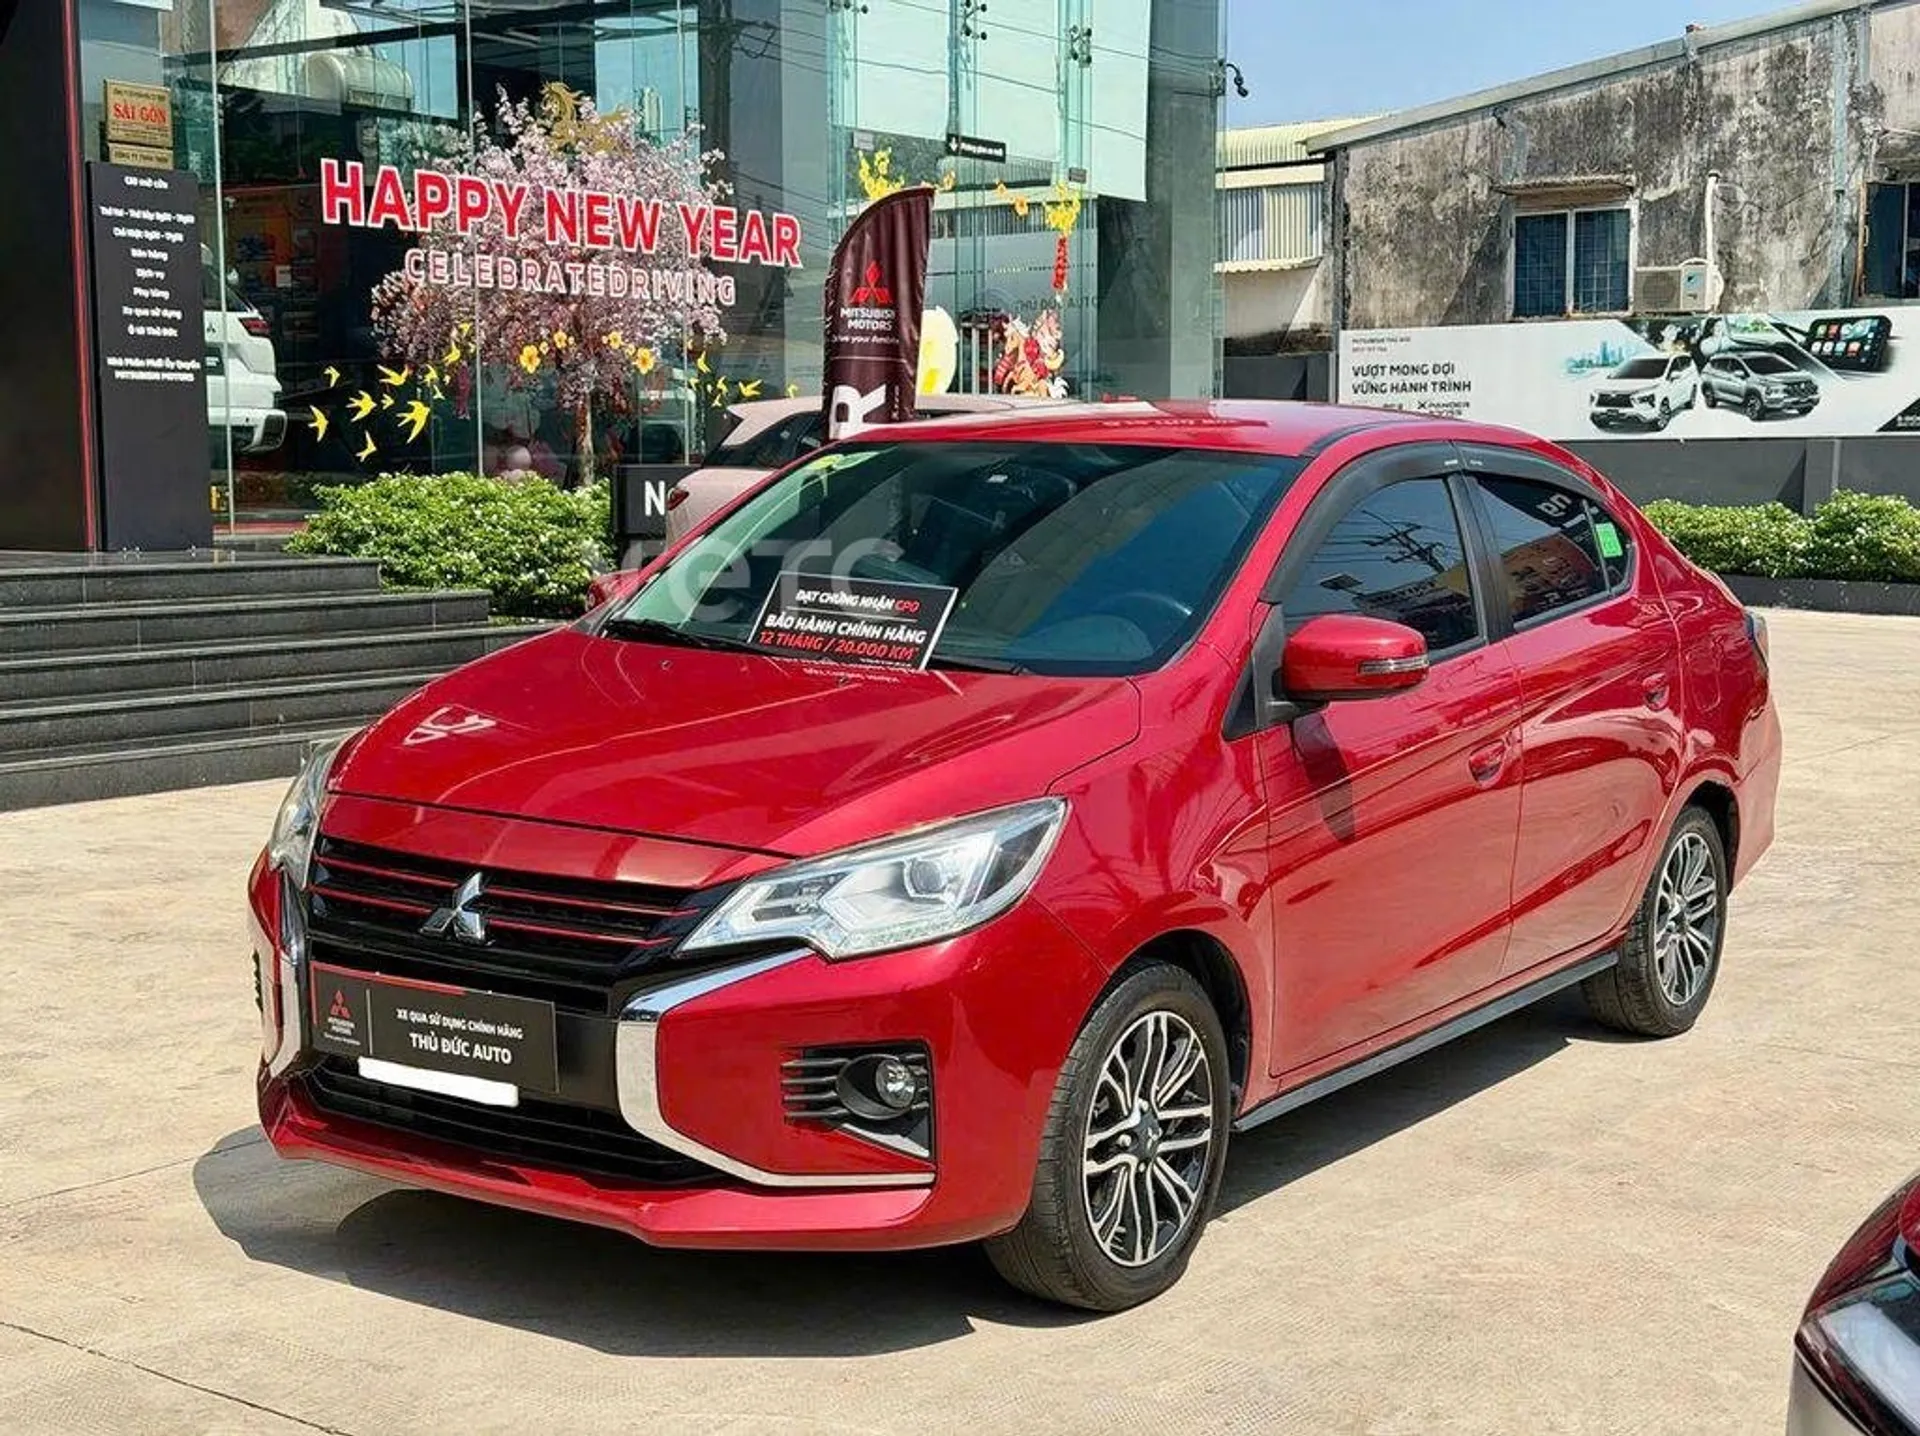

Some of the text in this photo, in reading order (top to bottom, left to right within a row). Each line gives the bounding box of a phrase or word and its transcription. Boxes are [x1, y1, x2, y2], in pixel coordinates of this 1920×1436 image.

[320, 158, 804, 269] HAPPY NEW YEAR
[848, 319, 893, 331] MOTORS
[1389, 363, 1430, 376] MONG
[894, 600, 920, 613] CPO
[765, 612, 794, 629] BẢO
[794, 616, 838, 634] HÀNH
[837, 619, 885, 639] CHÍNH
[759, 631, 774, 645] 12
[775, 630, 824, 650] THÁNG
[836, 639, 888, 658] 20.000
[408, 1010, 427, 1023] QUA
[409, 1030, 512, 1065] THỦ ĐỨC AUTO
